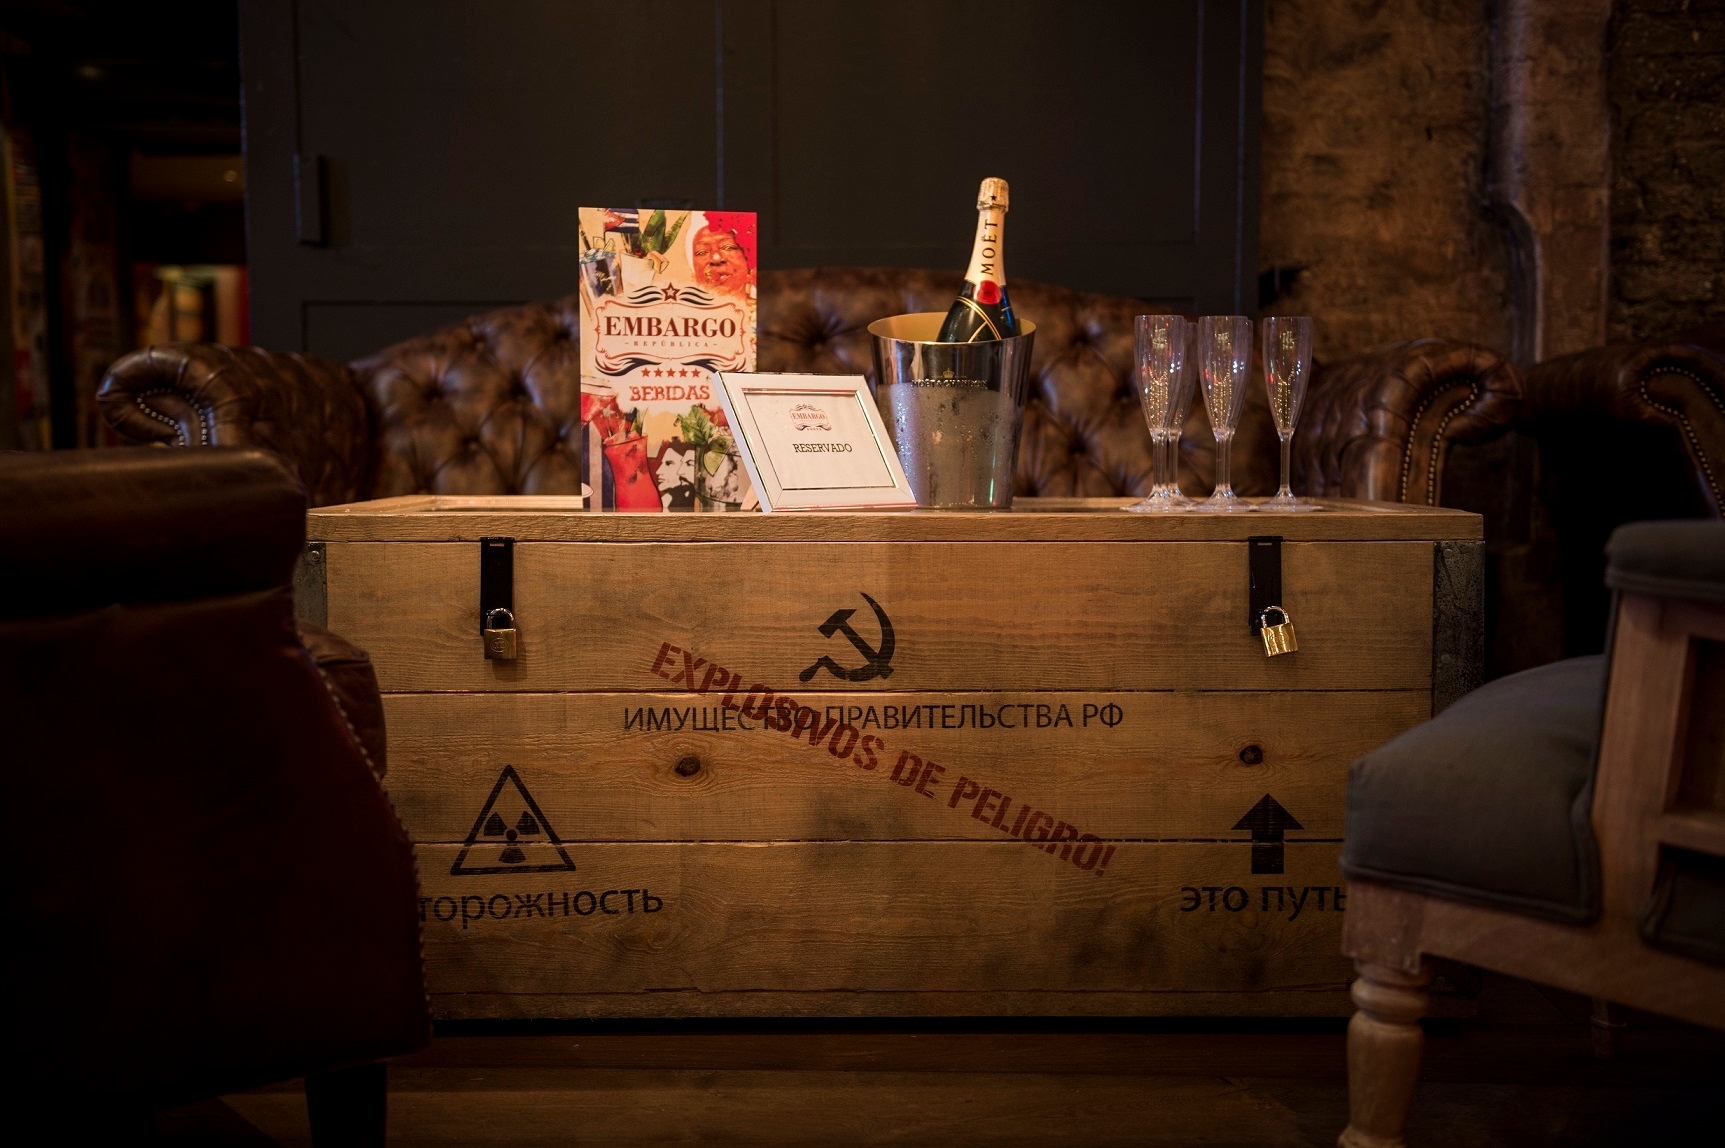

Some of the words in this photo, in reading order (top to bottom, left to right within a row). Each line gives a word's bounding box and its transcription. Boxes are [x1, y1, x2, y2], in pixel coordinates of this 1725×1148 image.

[980, 218, 998, 276] MOËT
[604, 316, 736, 338] EMBARGO
[629, 385, 711, 402] BEBIDAS
[792, 443, 853, 452] RESERVADO
[624, 705, 816, 733] ИМУЩЕСТВО
[825, 703, 1074, 730] ПРАВИТЕЛЬСТВА
[1082, 702, 1124, 728] РФ
[650, 641, 885, 771] EXPLOSIVOS
[889, 750, 947, 799] DE
[947, 775, 1117, 877] PELIGRO!
[1180, 886, 1249, 912] это
